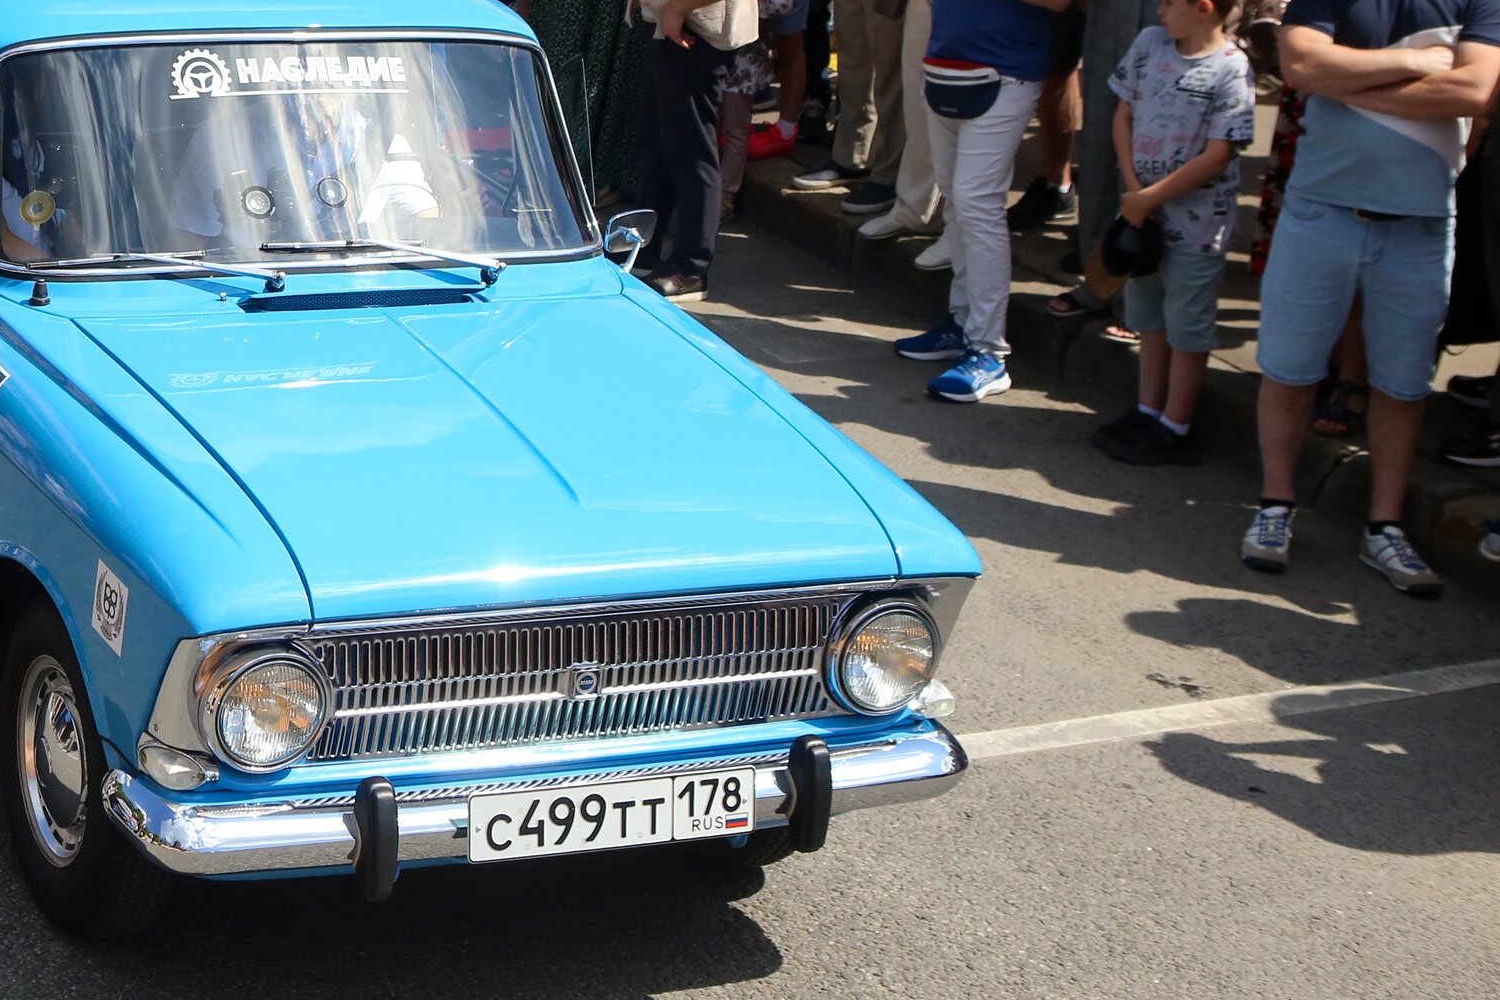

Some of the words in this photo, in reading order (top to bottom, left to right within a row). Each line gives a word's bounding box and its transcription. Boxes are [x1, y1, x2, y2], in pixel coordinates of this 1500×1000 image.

[235, 56, 407, 87] НАСЛЕДИЕ
[678, 776, 742, 818] 178
[692, 816, 724, 832] RUS
